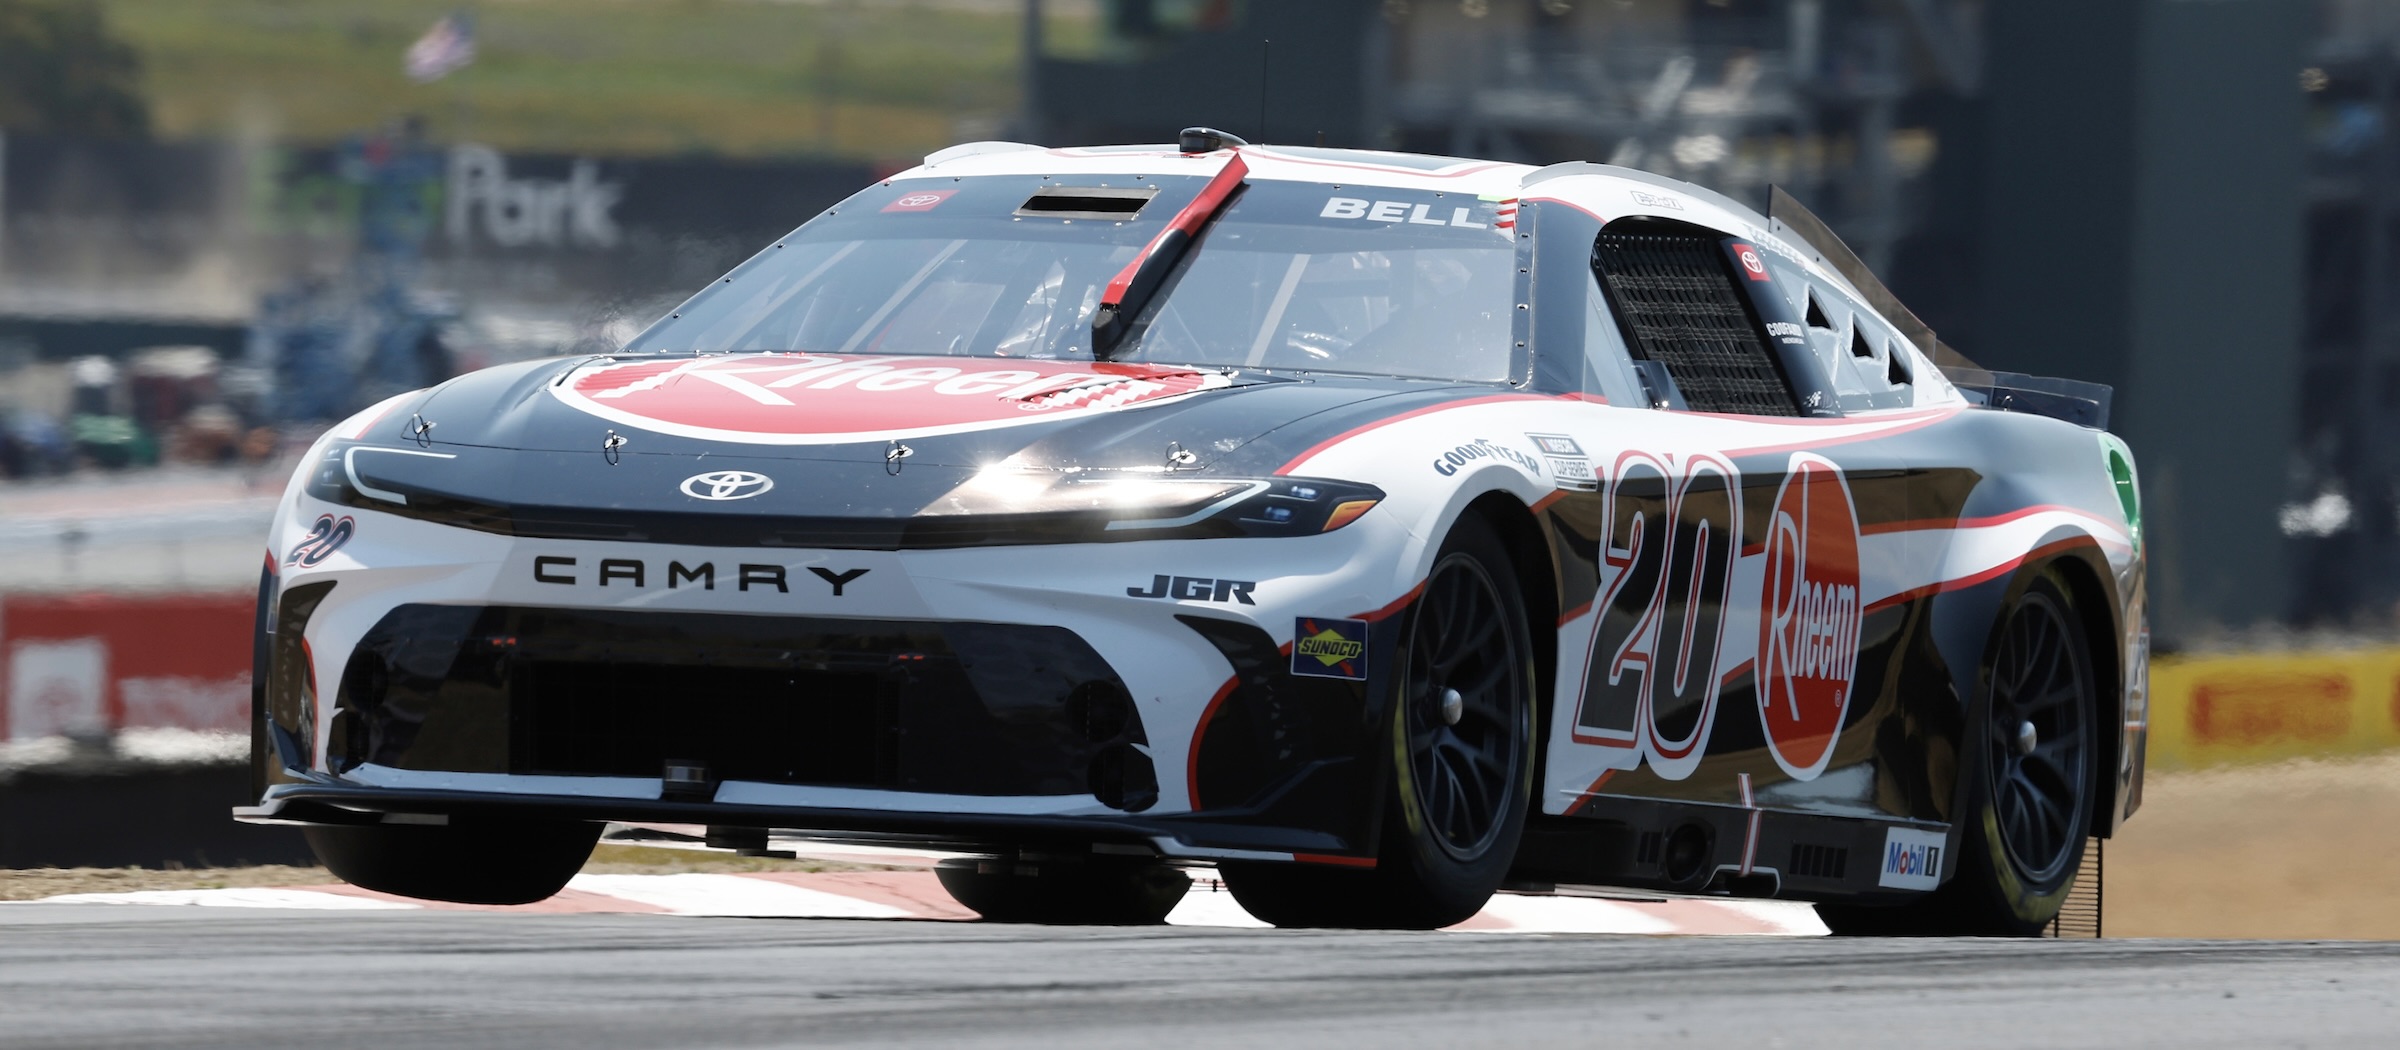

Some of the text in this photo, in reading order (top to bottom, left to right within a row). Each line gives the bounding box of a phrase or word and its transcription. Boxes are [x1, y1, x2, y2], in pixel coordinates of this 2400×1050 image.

[1319, 197, 1488, 230] BELL
[592, 353, 1166, 408] Rheem
[1433, 438, 1542, 478] GOODYEAR
[1554, 459, 1590, 477] CUP SERIES
[284, 513, 355, 568] 20
[534, 555, 872, 597] CAMRY
[1126, 574, 1256, 606] JGR
[1764, 463, 1856, 721] Rheem
[1572, 450, 1740, 762] 20
[1300, 638, 1361, 658] SUNOCO
[1886, 841, 1938, 876] Mobil 1
